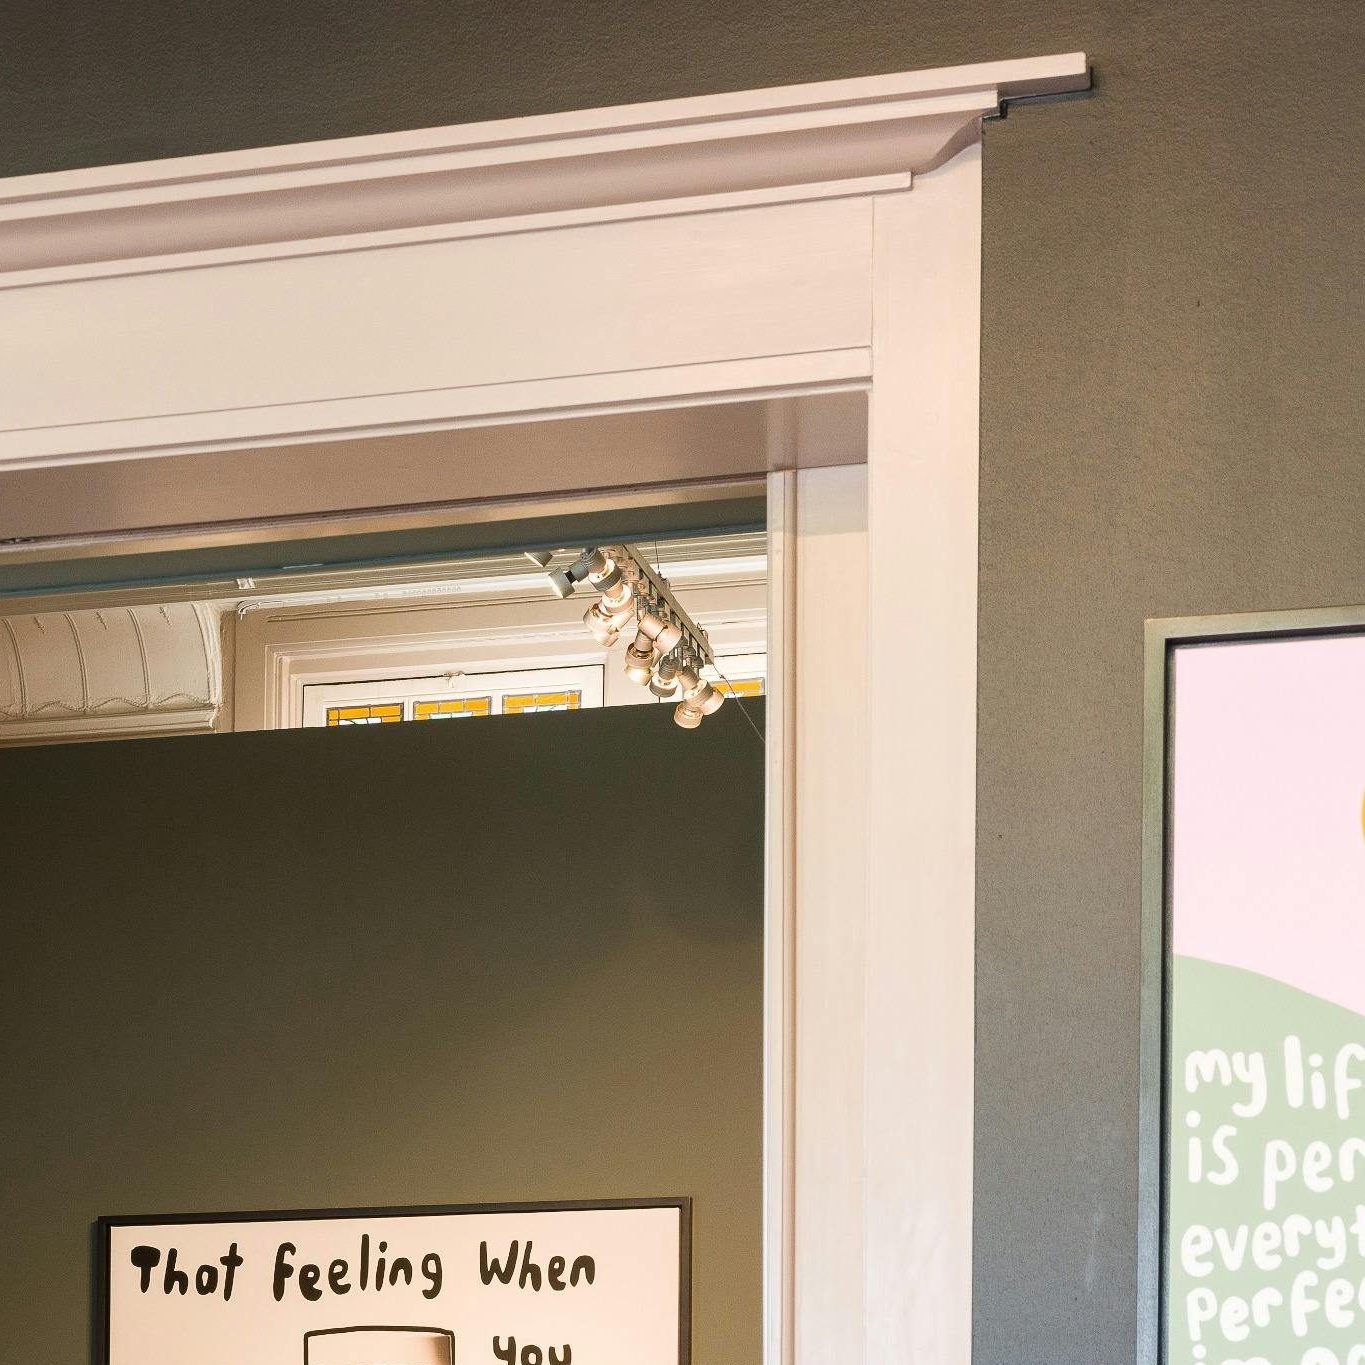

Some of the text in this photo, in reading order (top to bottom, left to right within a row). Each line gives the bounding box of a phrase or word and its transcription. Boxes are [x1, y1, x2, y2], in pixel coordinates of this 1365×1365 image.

[1184, 1048, 1268, 1118] my
[1185, 1110, 1239, 1186] is
[130, 1242, 244, 1302] That
[1187, 1270, 1365, 1342] perfe
